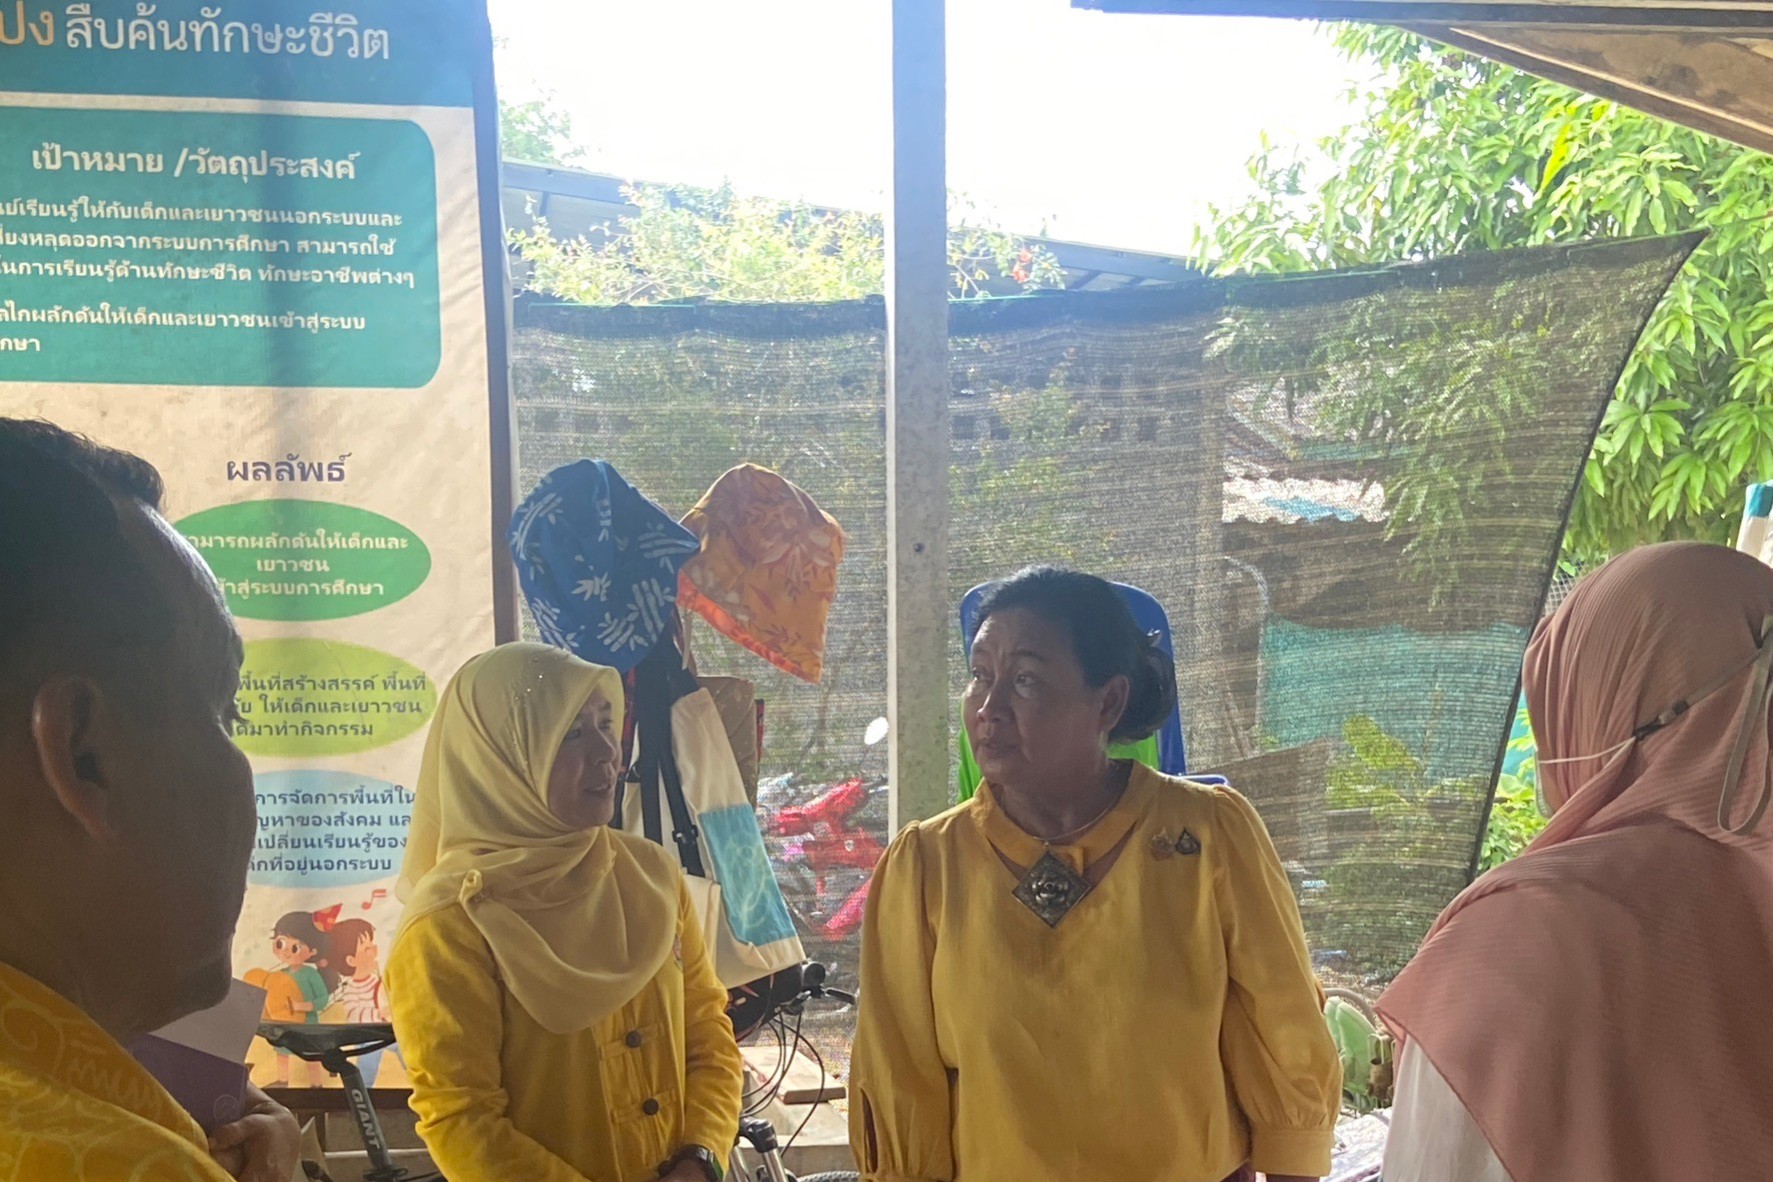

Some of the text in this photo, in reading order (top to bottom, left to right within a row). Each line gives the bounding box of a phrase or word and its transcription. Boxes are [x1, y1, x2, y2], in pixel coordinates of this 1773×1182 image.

[65, 2, 390, 60] สืบค้นทักษะชีวิต
[32, 142, 164, 173] เป้าหมาย
[297, 233, 396, 256] สามารถใช้
[0, 254, 415, 289] นการเรียนรู้ด้านทักษะชีวิต ทักษะอาชีพต่างๆ
[227, 452, 352, 482] ผลลัพธ์
[184, 528, 409, 550] ามารถผลักดันให้เด็กและ
[256, 559, 330, 573] เยาวชน
[259, 693, 422, 713] ให้เด็กและเยาวชน
[252, 830, 407, 853] เปลี่ยนเรียนรู้ของ
[351, 1088, 380, 1150] GIANT
